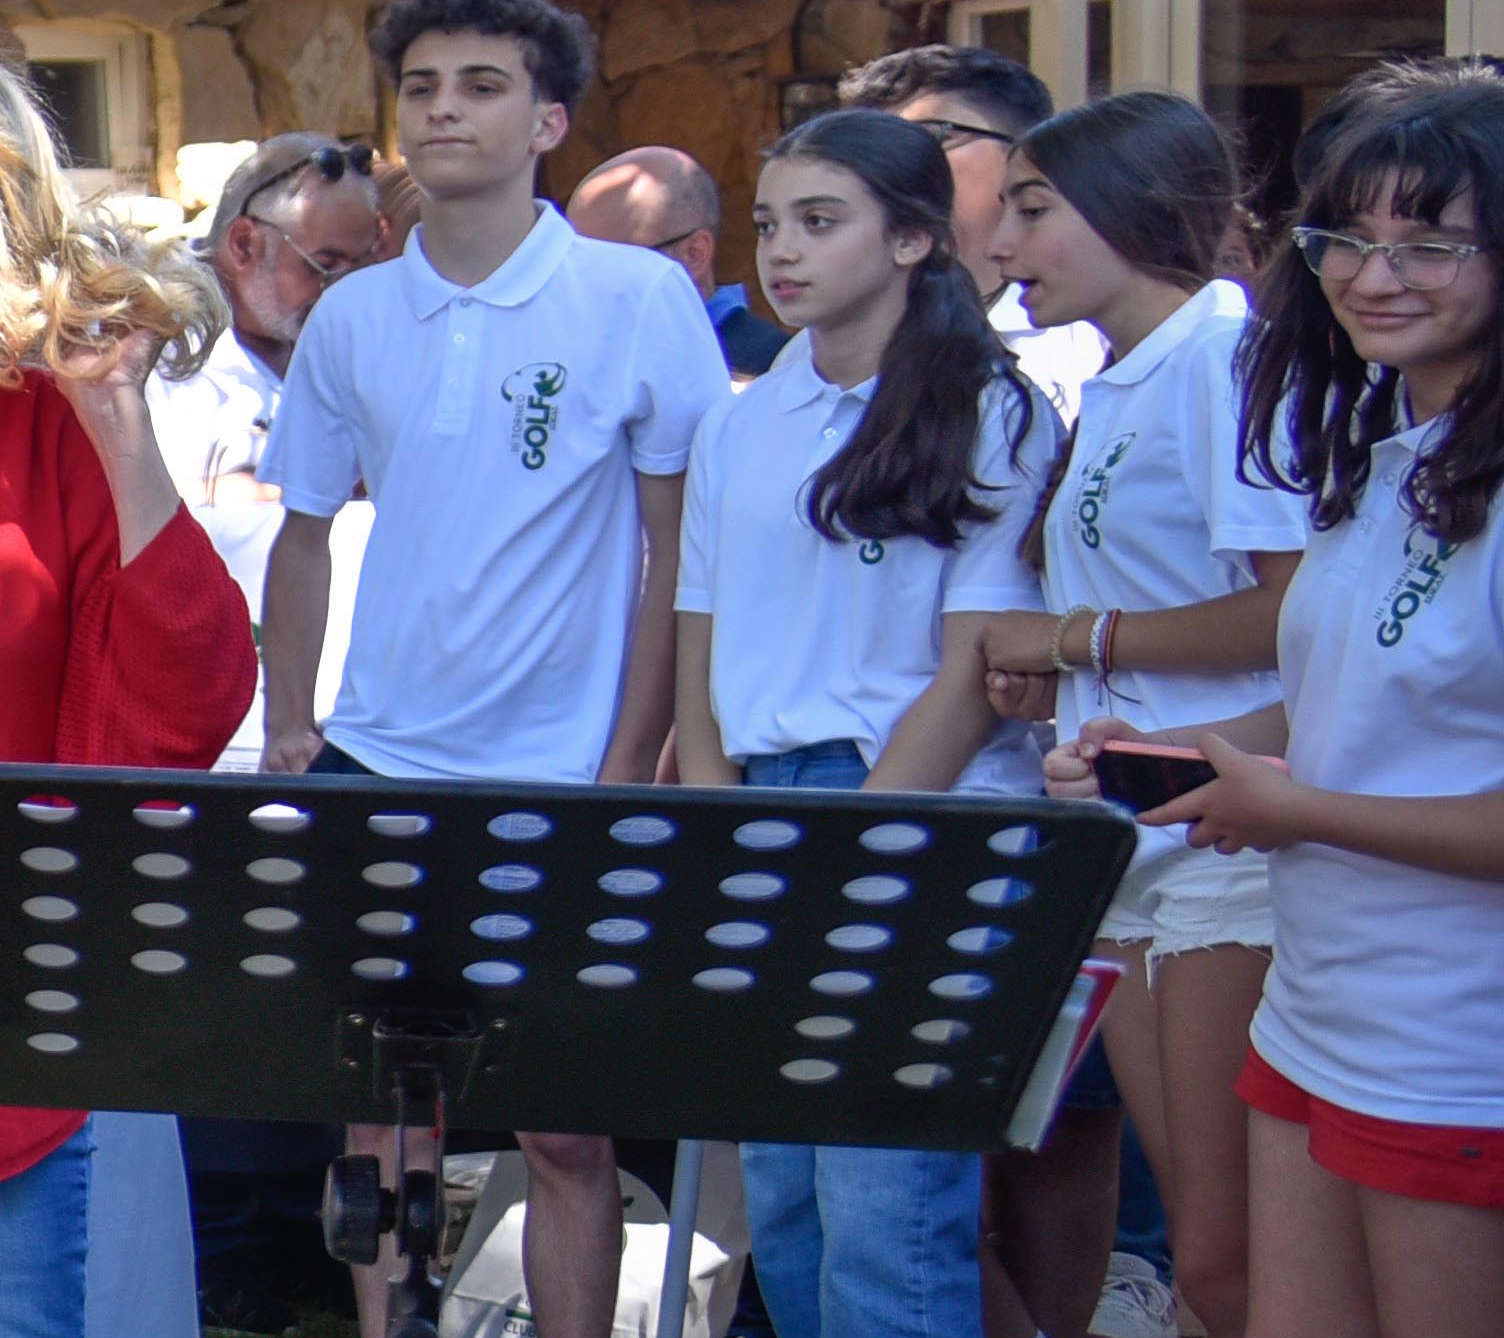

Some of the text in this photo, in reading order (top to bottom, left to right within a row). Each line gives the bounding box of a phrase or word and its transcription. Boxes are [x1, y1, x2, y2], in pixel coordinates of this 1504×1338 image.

[512, 393, 526, 439] TORNEO
[521, 395, 551, 471] GOLF
[1078, 468, 1107, 550] GOLF
[1376, 554, 1441, 649] GOLF
[1384, 549, 1425, 603] TORNEO
